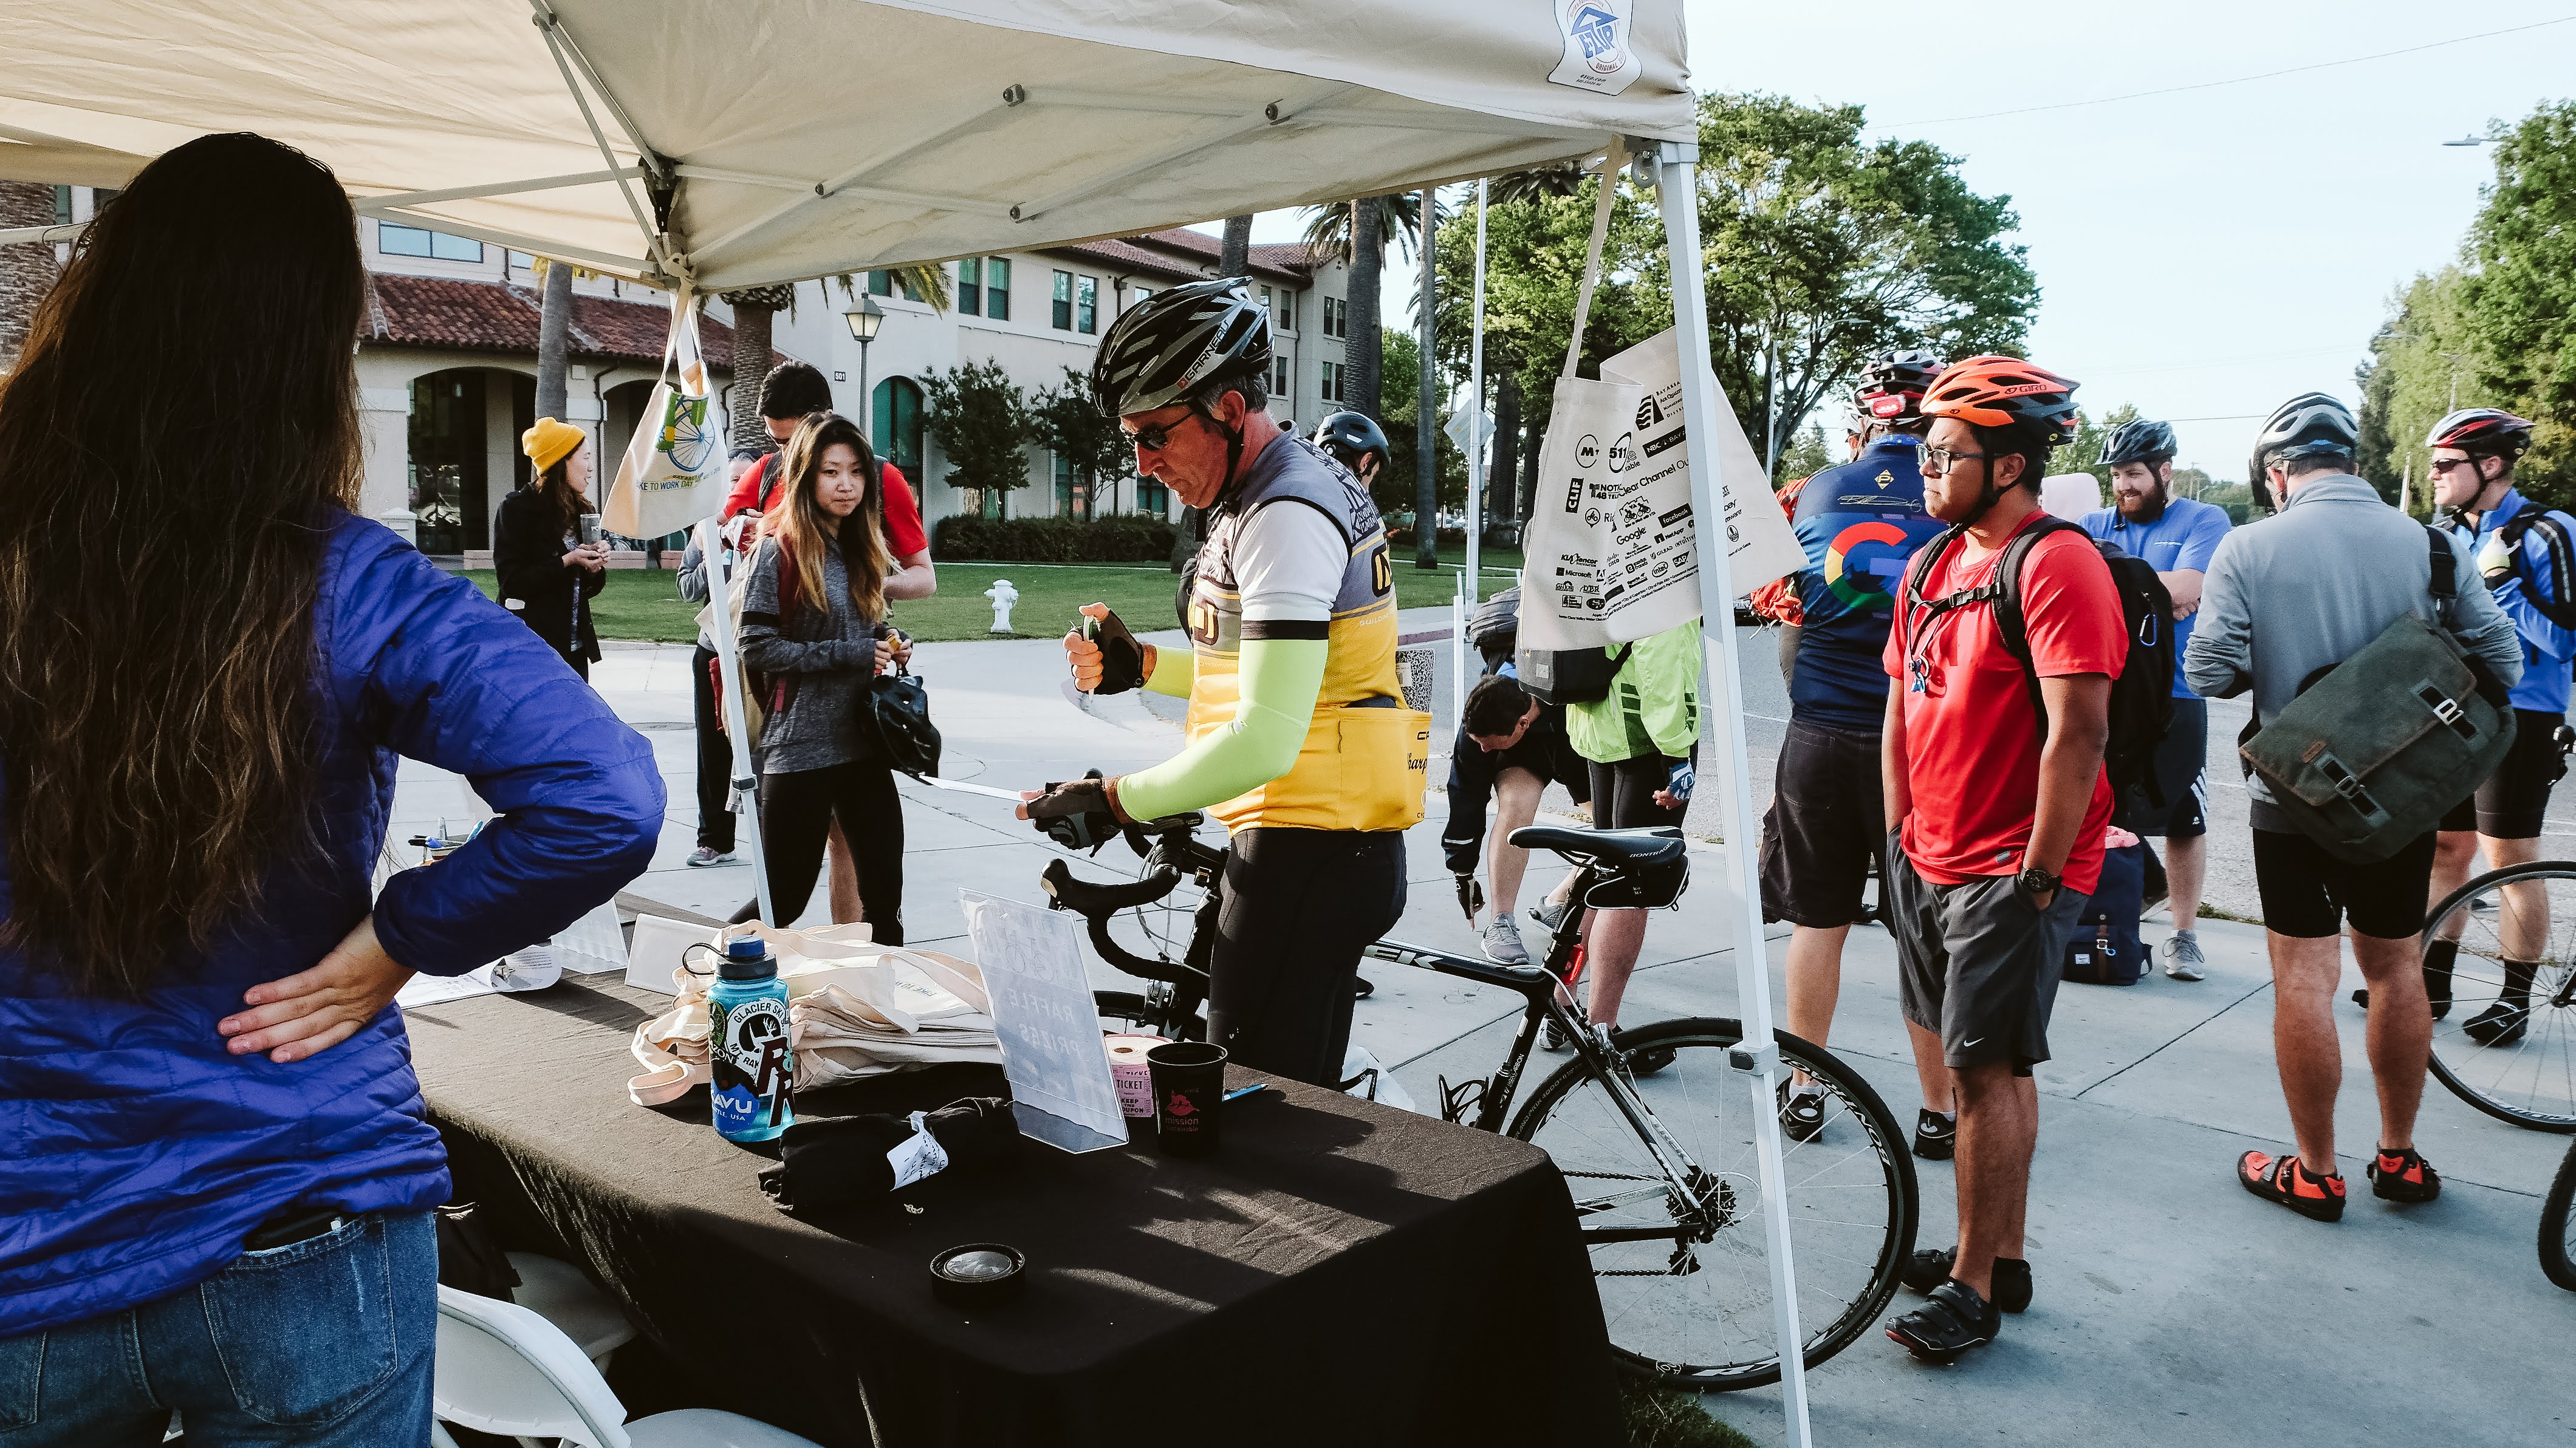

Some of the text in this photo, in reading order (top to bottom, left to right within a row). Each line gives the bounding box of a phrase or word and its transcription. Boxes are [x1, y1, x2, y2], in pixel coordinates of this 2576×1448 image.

[1595, 63, 1618, 71] ORIGINAL
[1185, 319, 1229, 381] GARNEAU
[2019, 384, 2047, 393] GIRO
[1646, 434, 1681, 452] NBC BAY
[1609, 447, 1628, 459] 511
[1640, 464, 1676, 487] Channel
[660, 481, 680, 490] WORK
[1569, 481, 1581, 508] CLIF
[1663, 509, 1688, 524] facebook
[1617, 527, 1647, 545] Google
[1665, 528, 1684, 540] NetApp
[1657, 546, 1673, 556] GILEAD
[1673, 555, 1687, 564] SAP
[1566, 570, 1592, 578] Microsoft
[1629, 841, 1675, 858] BONTRAGER
[1363, 945, 1444, 970] EK
[733, 1002, 784, 1023] GLACIER SKI
[1117, 1079, 1143, 1090] TICKET
[730, 1113, 745, 1121] USA
[1165, 1117, 1199, 1125] mission
